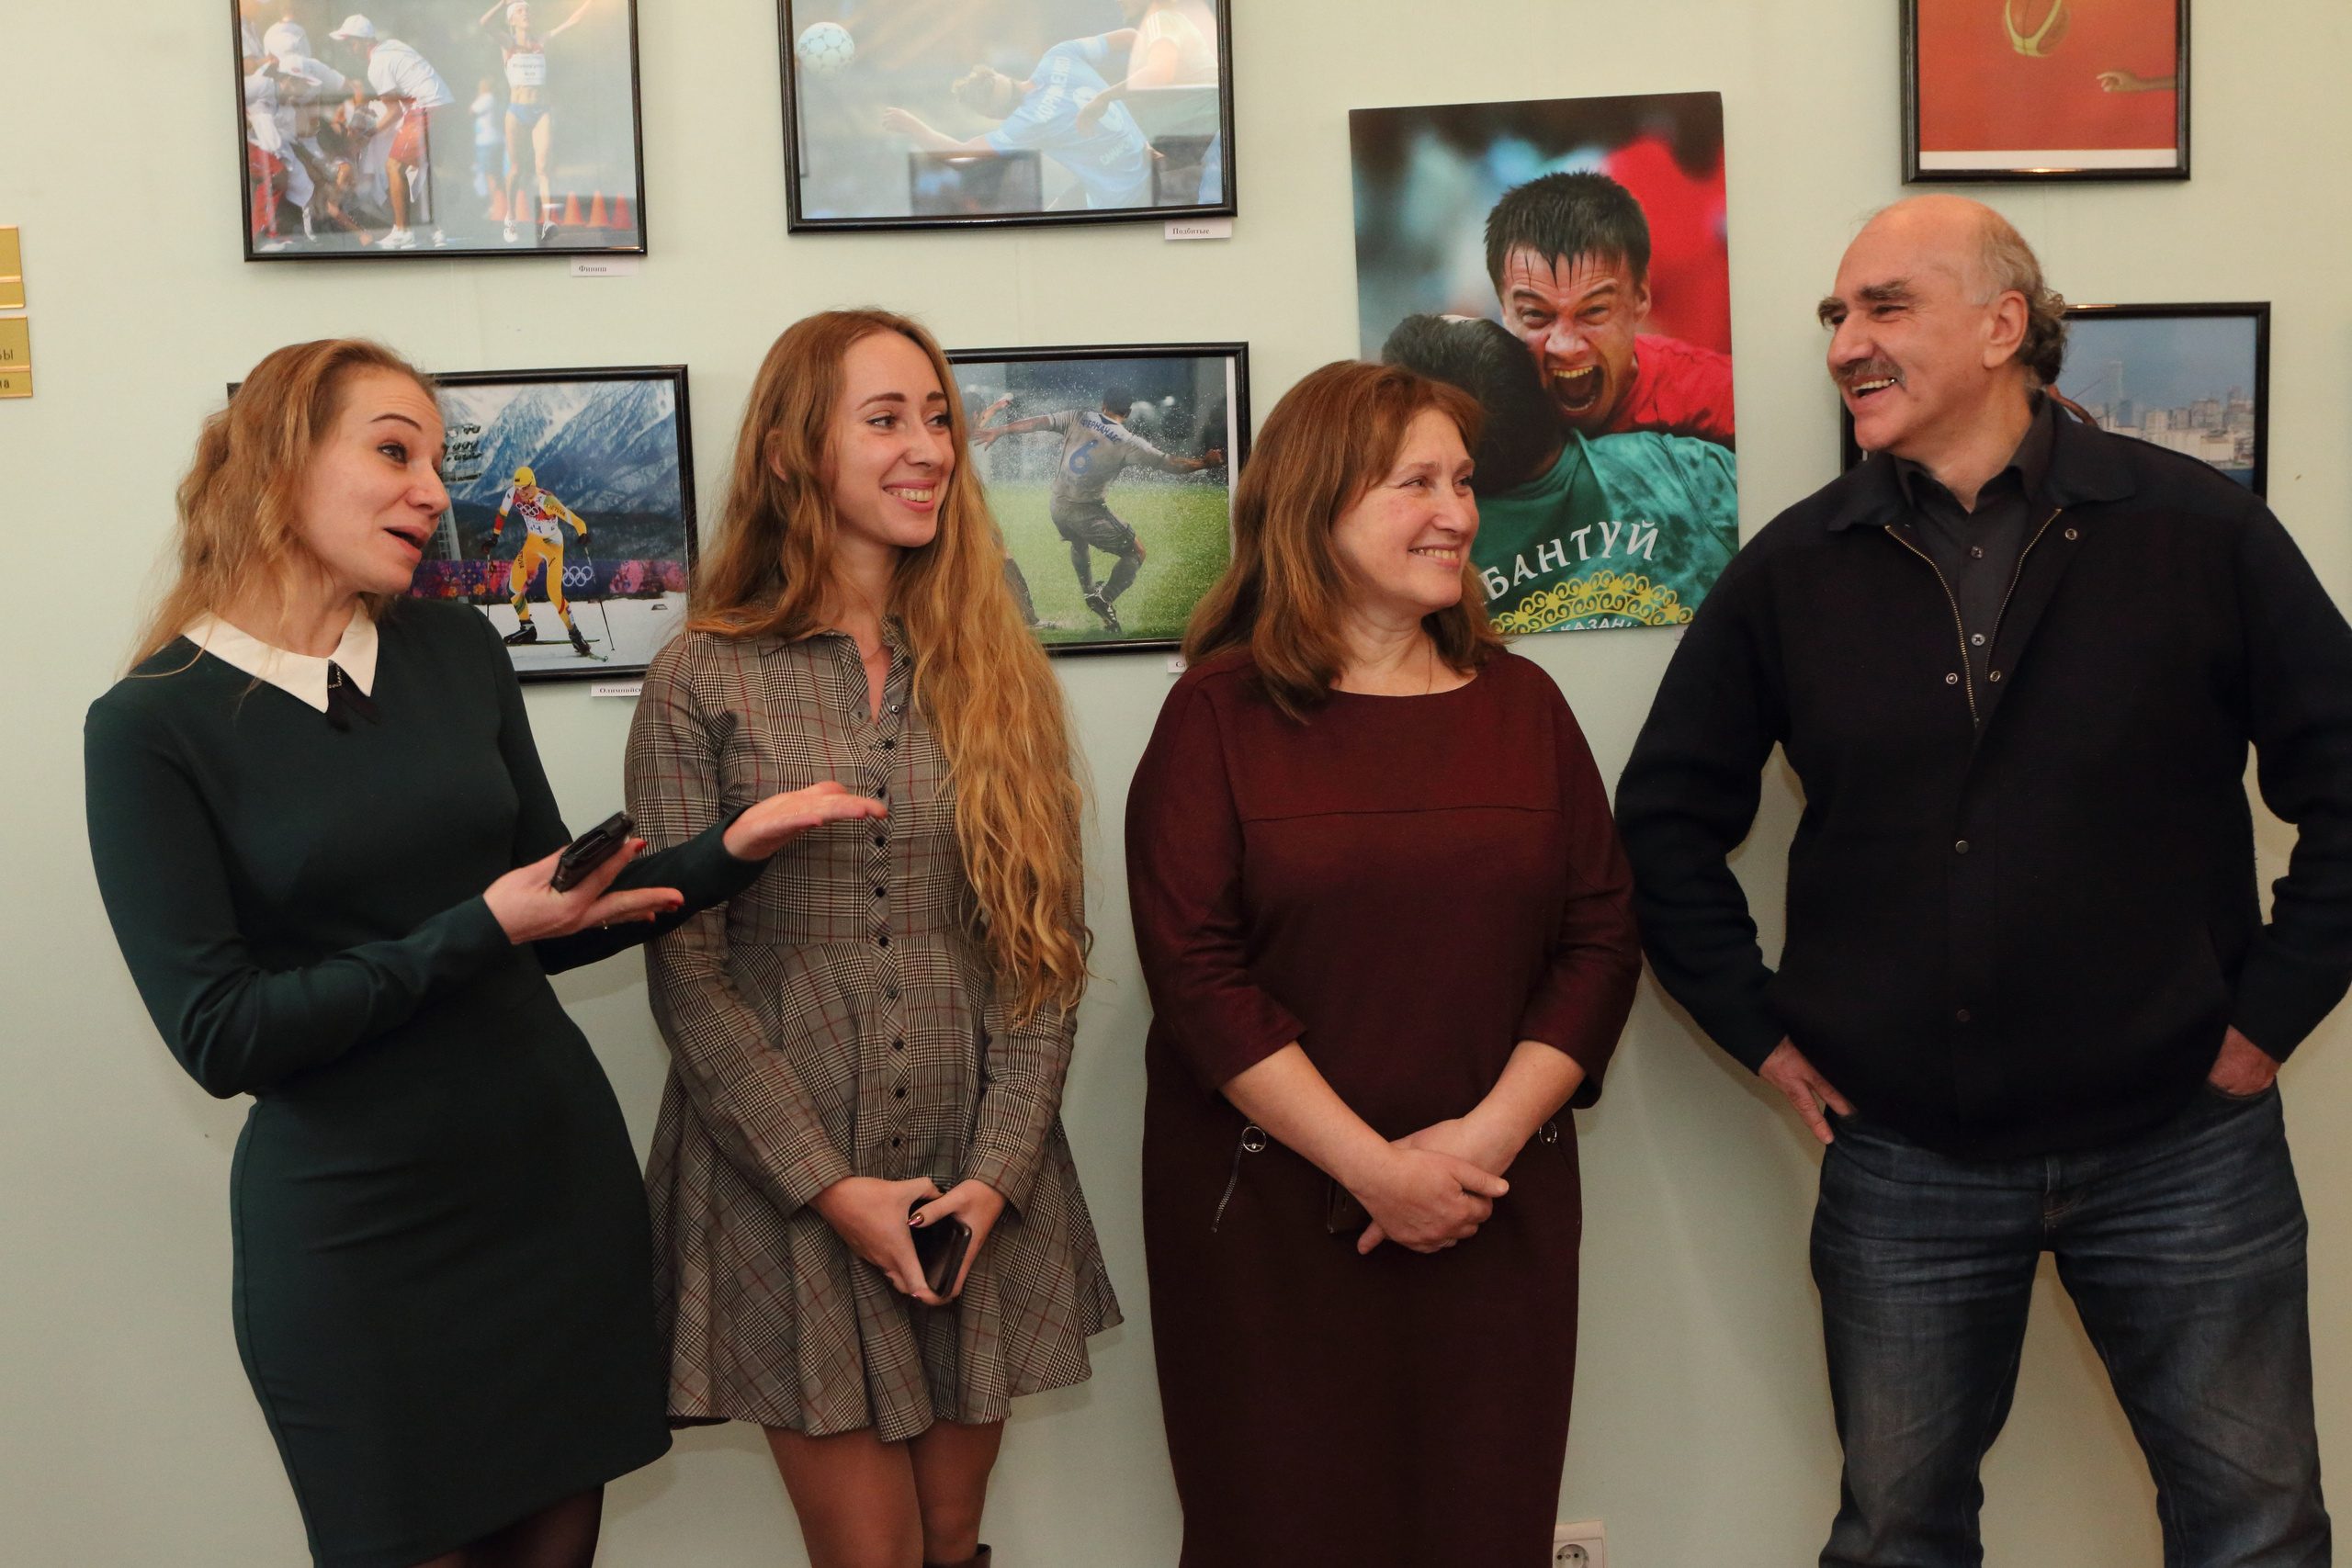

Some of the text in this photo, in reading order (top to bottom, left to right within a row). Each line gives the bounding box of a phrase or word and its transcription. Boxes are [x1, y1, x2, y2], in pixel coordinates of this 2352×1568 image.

[1172, 227, 1210, 235] Подбитые
[578, 265, 607, 273] Финиш
[1069, 439, 1098, 475] 6
[546, 503, 566, 516] LIETUVA
[1478, 520, 1658, 602] БАНТУЙ
